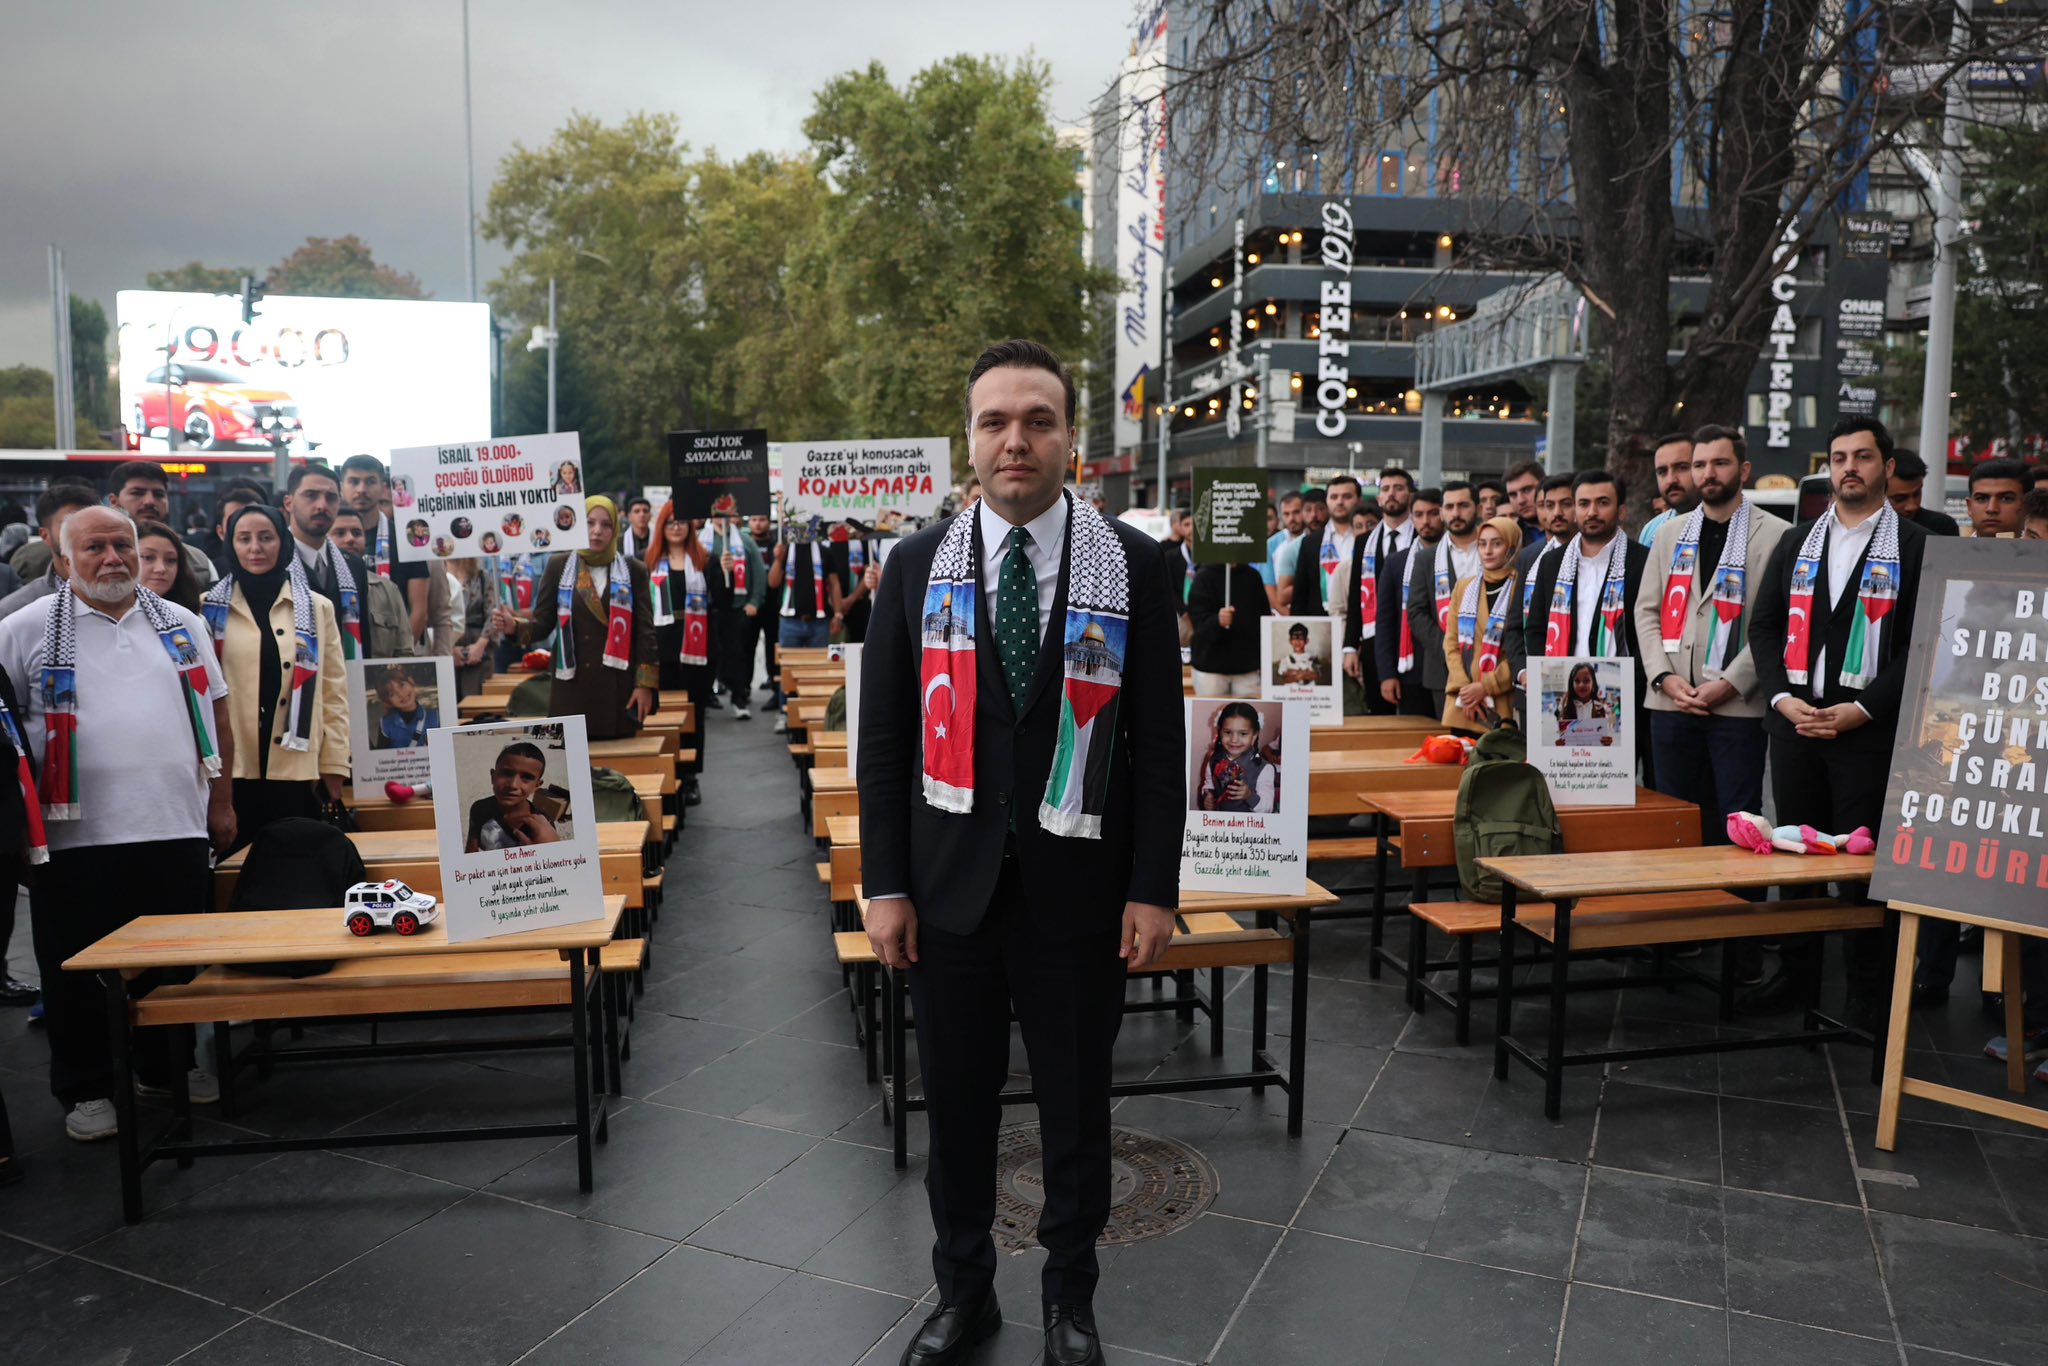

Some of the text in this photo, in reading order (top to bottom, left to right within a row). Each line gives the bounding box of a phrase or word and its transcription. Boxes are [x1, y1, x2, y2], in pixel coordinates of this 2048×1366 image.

[1840, 299, 1884, 314] ONUR
[1316, 280, 1351, 437] COFFEE
[720, 435, 743, 448] YOK
[438, 444, 522, 464] İSRAİL 19.000+
[684, 449, 753, 463] SAYACAKLAR
[807, 448, 858, 465] Gazze'yi
[435, 463, 533, 492] ÇOCUĞU ÖLDÜRDÜ
[801, 466, 821, 477] tek
[825, 465, 847, 477] SEN
[908, 462, 931, 479] gibi
[418, 488, 557, 517] HİÇBİRİNİN SİLAHI YOKTU
[821, 494, 876, 509] DEVAM
[882, 493, 899, 506] ET
[1951, 628, 2048, 663] SIRA
[1982, 672, 2048, 715] BOŞ
[1949, 748, 2048, 795] İSRA
[1202, 813, 1225, 827] Benim
[1227, 816, 1245, 828] adım
[1901, 790, 2044, 838] ÇOCUKL
[1186, 829, 1209, 848] Bugün
[1210, 830, 1229, 843] okula
[504, 849, 517, 861] Ben
[1192, 847, 1213, 859] henüz
[1214, 847, 1220, 859] 6
[1221, 849, 1248, 863] yaşında
[1249, 848, 1266, 861] 355
[1267, 850, 1299, 863] kurşunla
[454, 854, 587, 885] Bir paket un için tam on iki kilometre yolu
[1225, 864, 1242, 877] şehit
[491, 880, 508, 896] yalın
[508, 877, 524, 893] ayak
[479, 895, 501, 908] Evime
[501, 892, 537, 905] dönemeden
[490, 909, 497, 920] 9
[497, 906, 522, 924] yaşında
[523, 905, 538, 918] şehit
